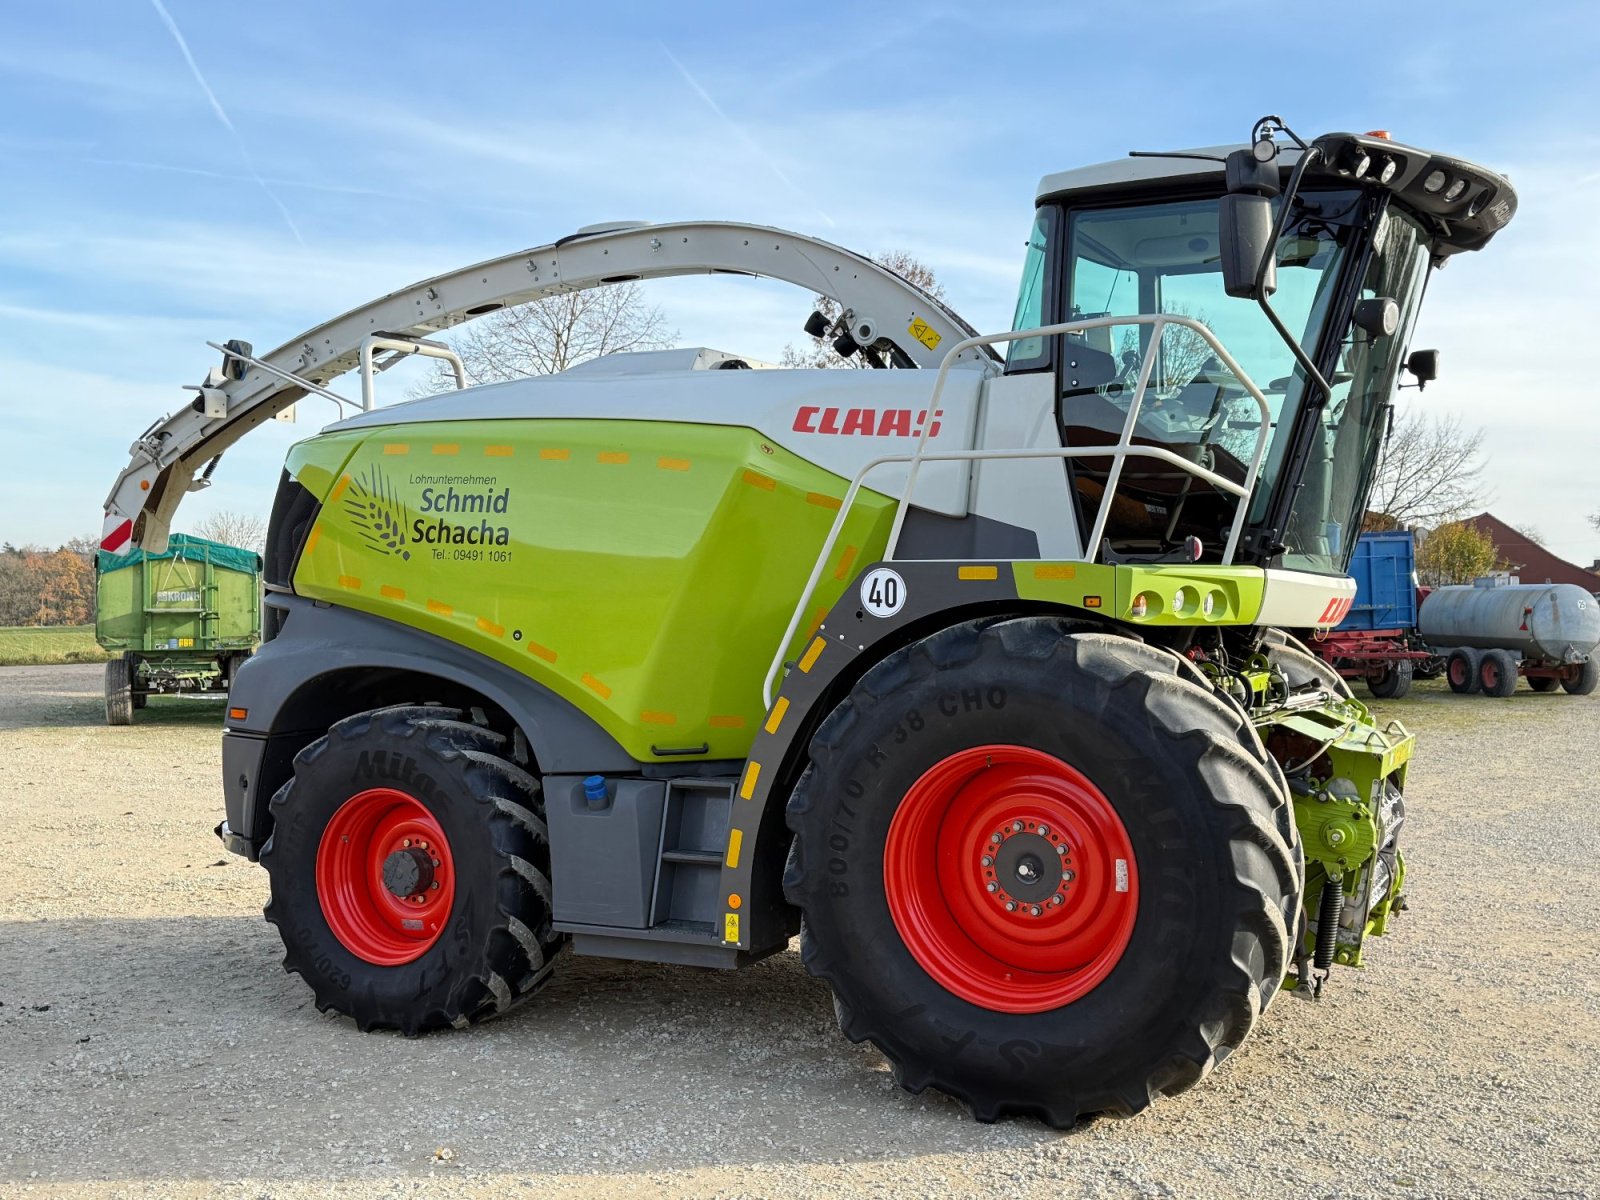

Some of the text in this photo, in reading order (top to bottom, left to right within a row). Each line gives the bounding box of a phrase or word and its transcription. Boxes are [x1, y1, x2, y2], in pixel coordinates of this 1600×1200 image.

[792, 406, 944, 438] CLAAS
[409, 474, 496, 485] Lohnunternehmen
[420, 486, 510, 514] Schmid
[411, 517, 510, 546] Schacha
[432, 549, 512, 562] Tel.: 09491 1061
[868, 577, 898, 609] 40
[828, 778, 865, 899] 800/70
[892, 708, 926, 745] 38
[937, 685, 1008, 718] CHO
